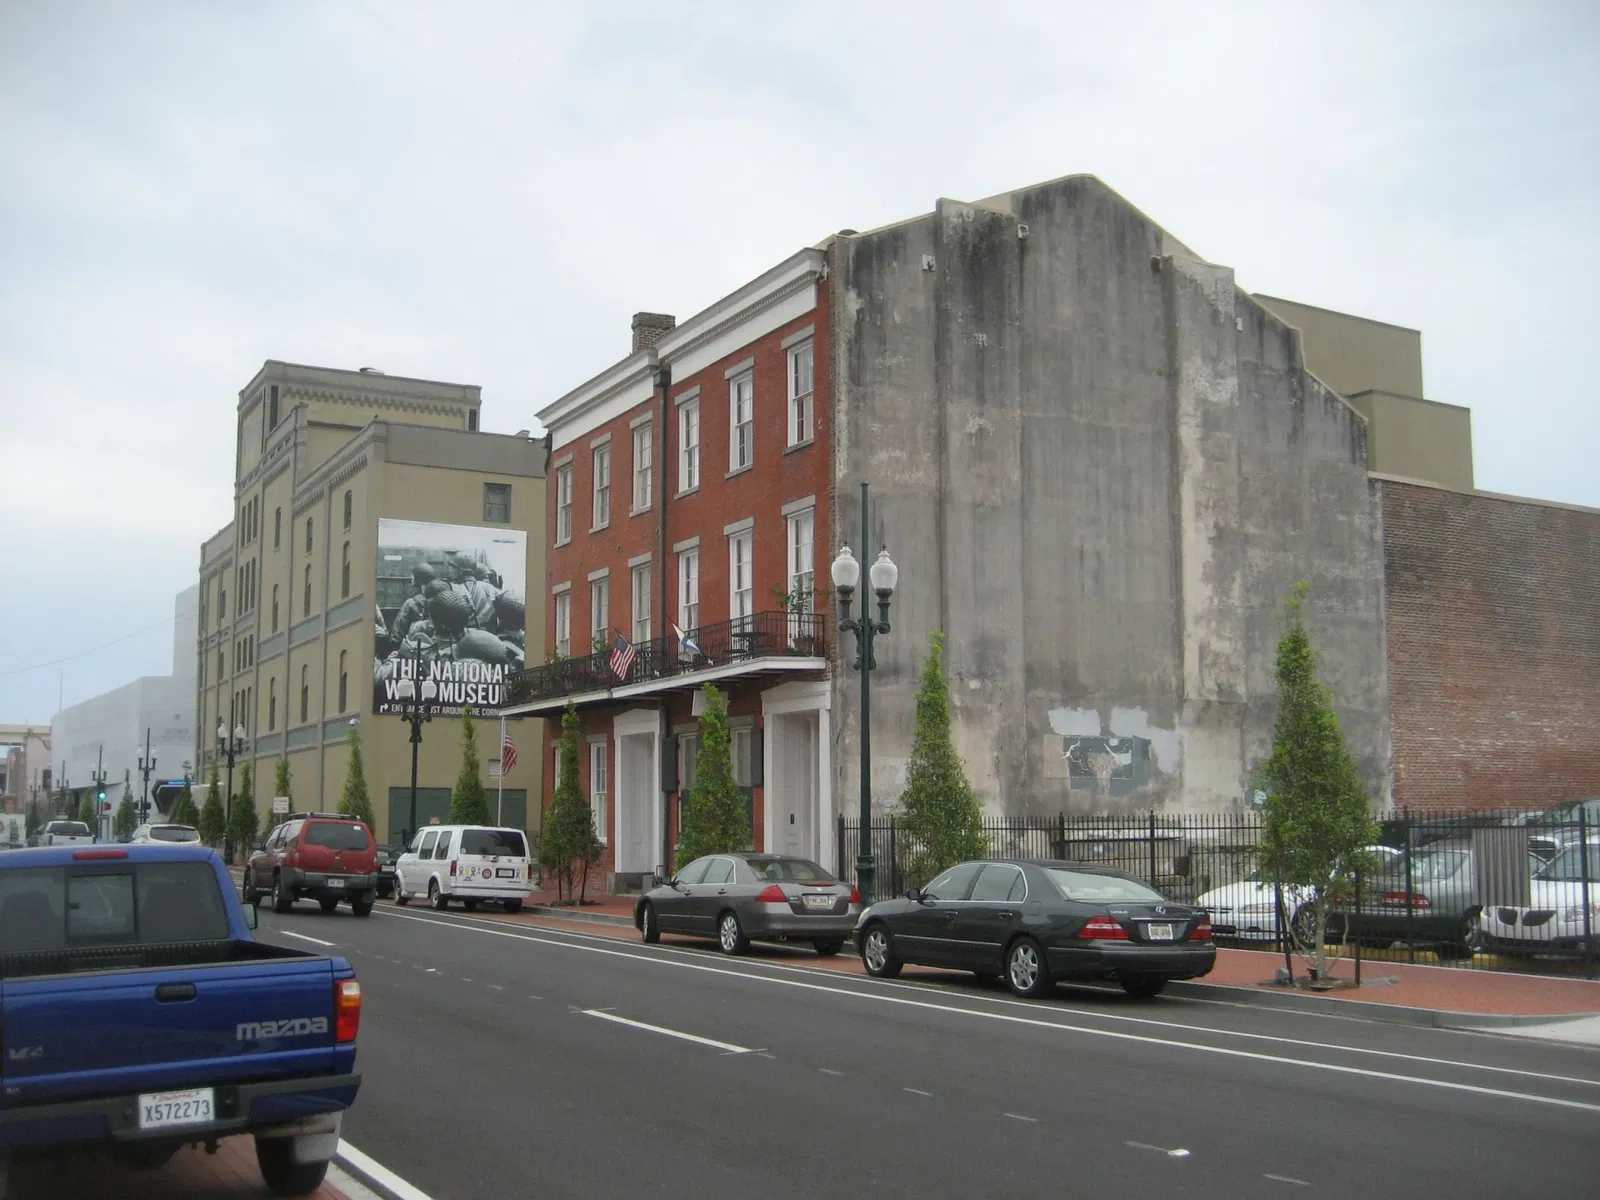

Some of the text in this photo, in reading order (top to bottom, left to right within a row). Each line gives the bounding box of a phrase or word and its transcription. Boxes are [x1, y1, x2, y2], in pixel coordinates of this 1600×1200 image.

[390, 658, 424, 680] THE
[439, 681, 503, 705] MUSEU
[441, 706, 465, 715] AROUN
[469, 707, 481, 716] HE
[481, 708, 500, 717] CORN
[144, 1100, 211, 1122] X572273
